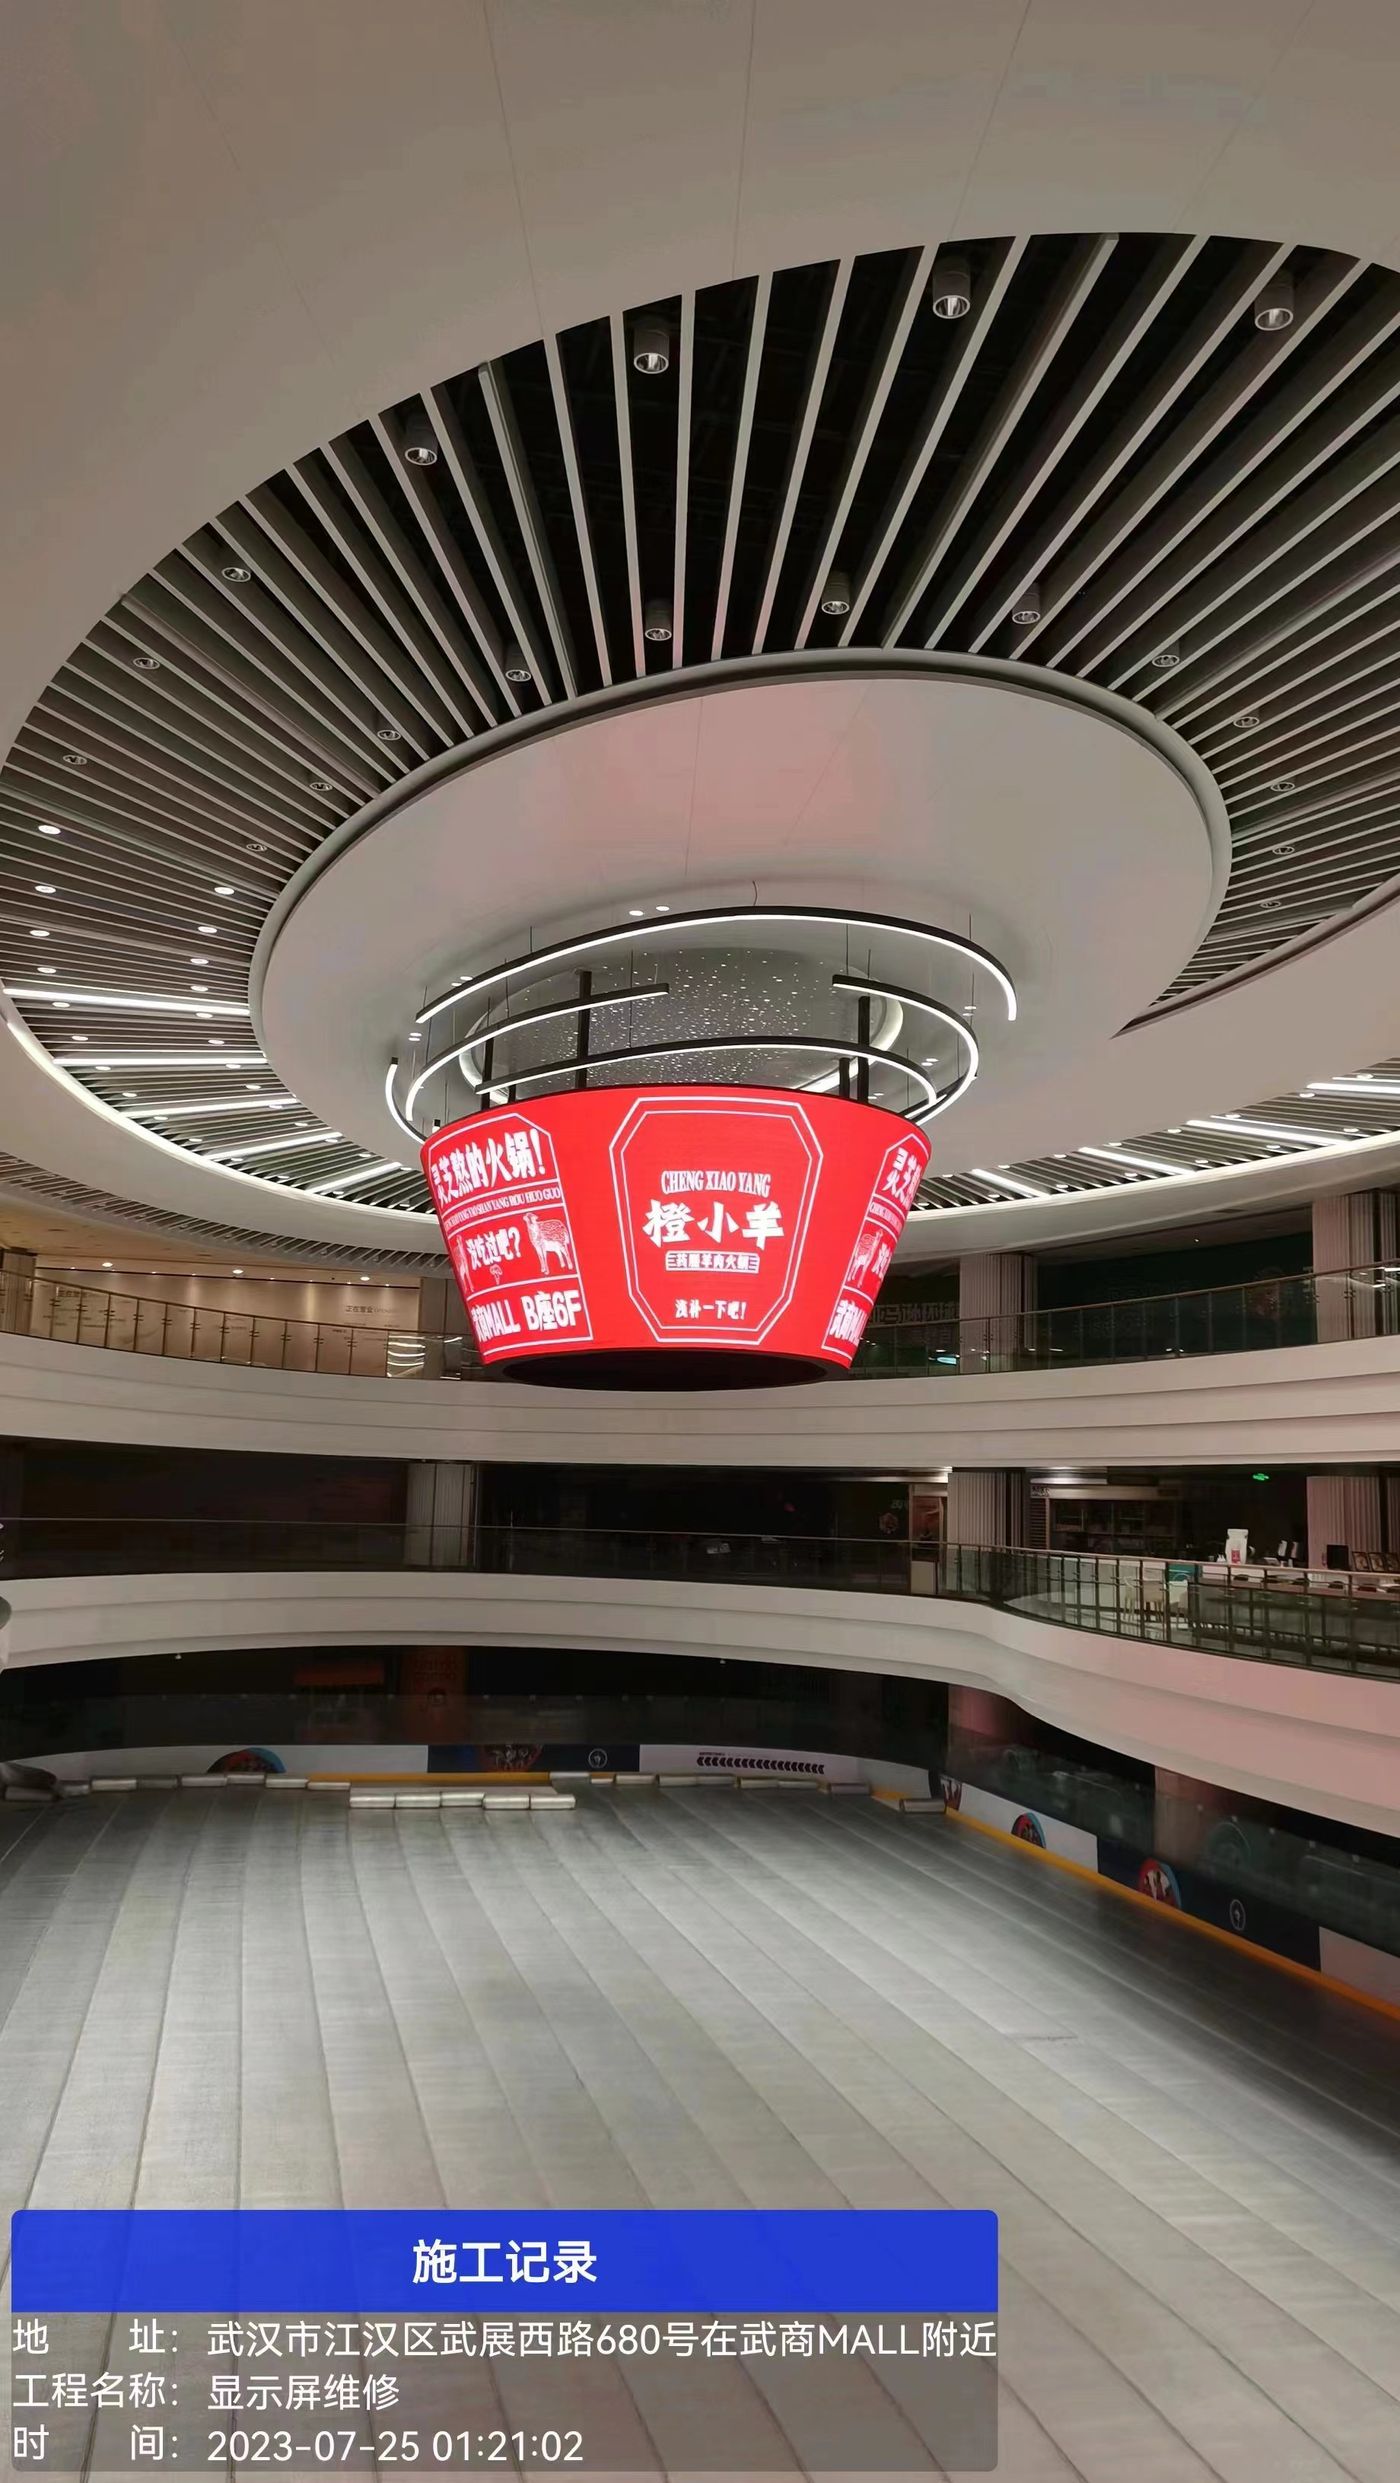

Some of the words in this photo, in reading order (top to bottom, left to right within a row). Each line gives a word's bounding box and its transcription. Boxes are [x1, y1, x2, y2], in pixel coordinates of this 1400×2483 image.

[543, 1187, 561, 1200] GUO
[661, 1170, 704, 1195] CHENG
[705, 1171, 737, 1191] XIAO
[738, 1172, 771, 1198] YANG
[642, 1199, 785, 1251] 橙小羊
[520, 1290, 582, 1332] B座6F
